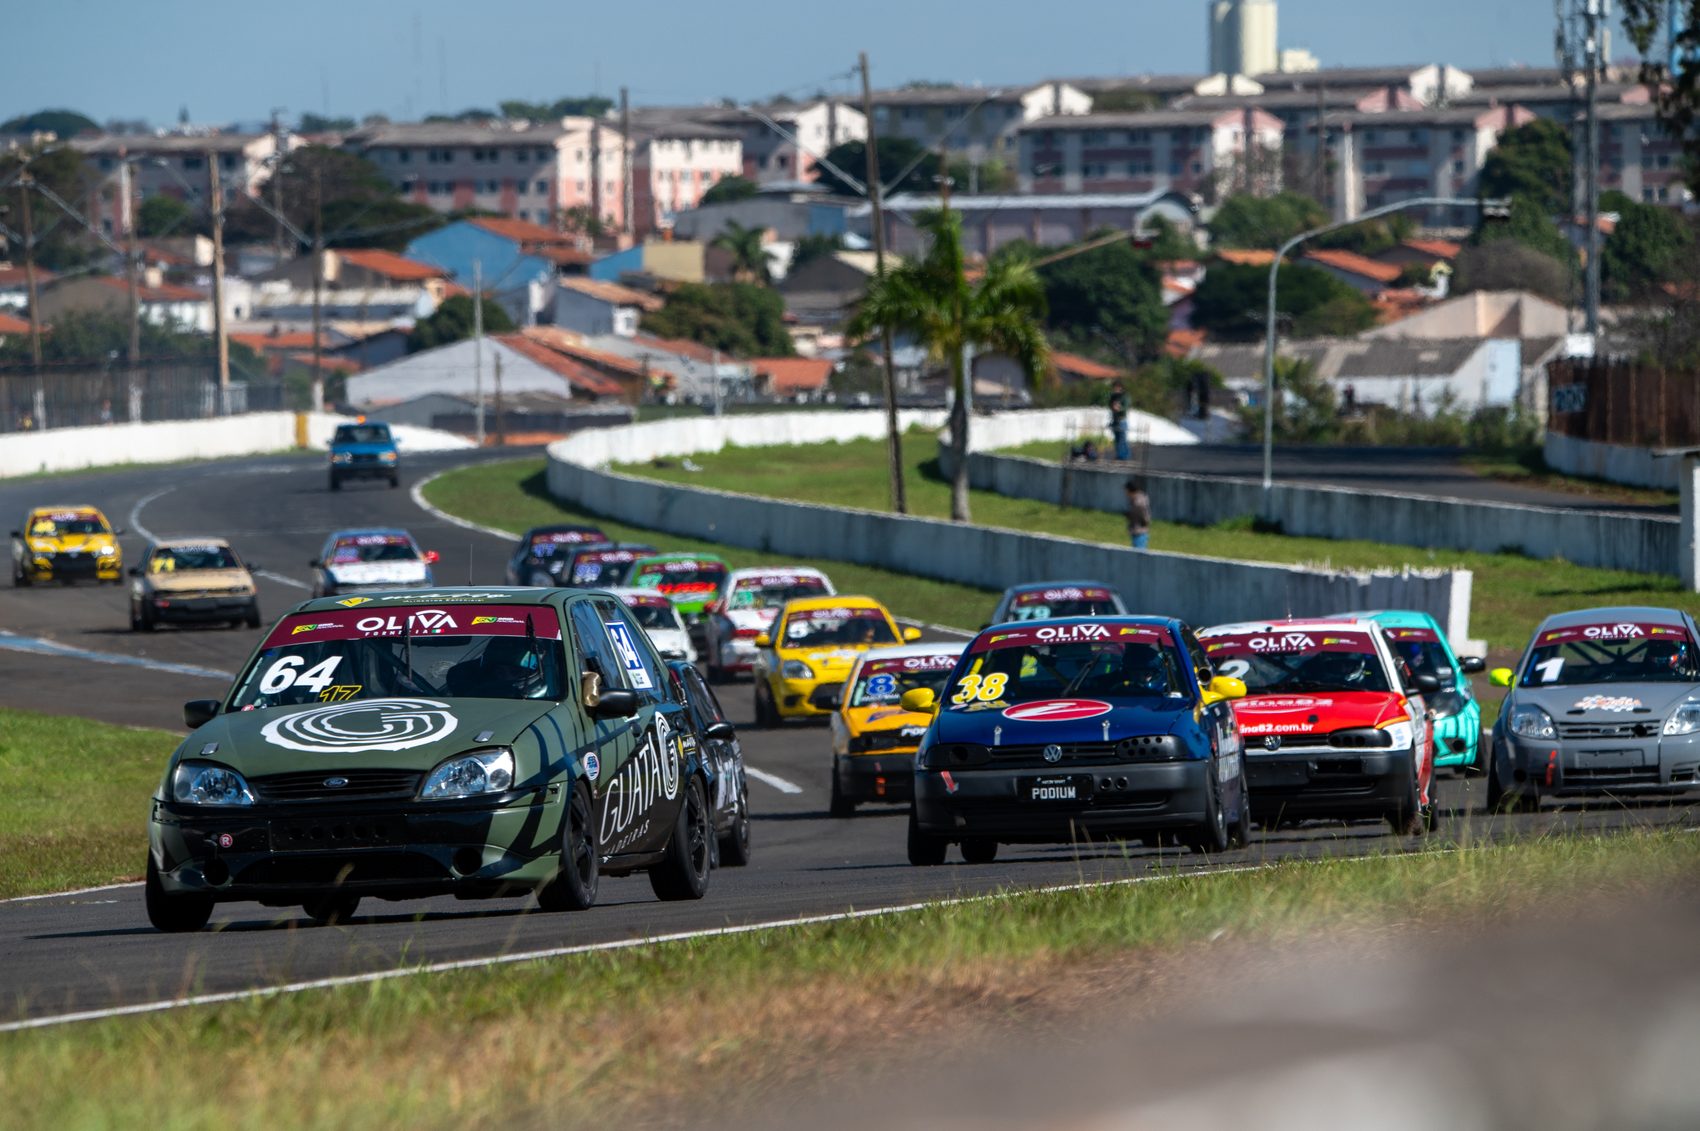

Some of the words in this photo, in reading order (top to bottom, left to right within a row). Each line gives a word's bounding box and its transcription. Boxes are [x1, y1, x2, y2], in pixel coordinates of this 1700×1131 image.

[356, 609, 458, 632] OLIVA
[1583, 624, 1644, 637] OLIVA
[365, 629, 428, 637] FORNEIA
[1036, 624, 1110, 640] OLIVA
[1248, 633, 1316, 650] OLIVA
[610, 628, 640, 668] 64
[259, 655, 344, 695] 64
[1534, 657, 1566, 683] 1
[319, 684, 363, 703] 17
[866, 672, 896, 697] 8
[951, 672, 1009, 705] 38
[1032, 786, 1076, 800] PODIUM
